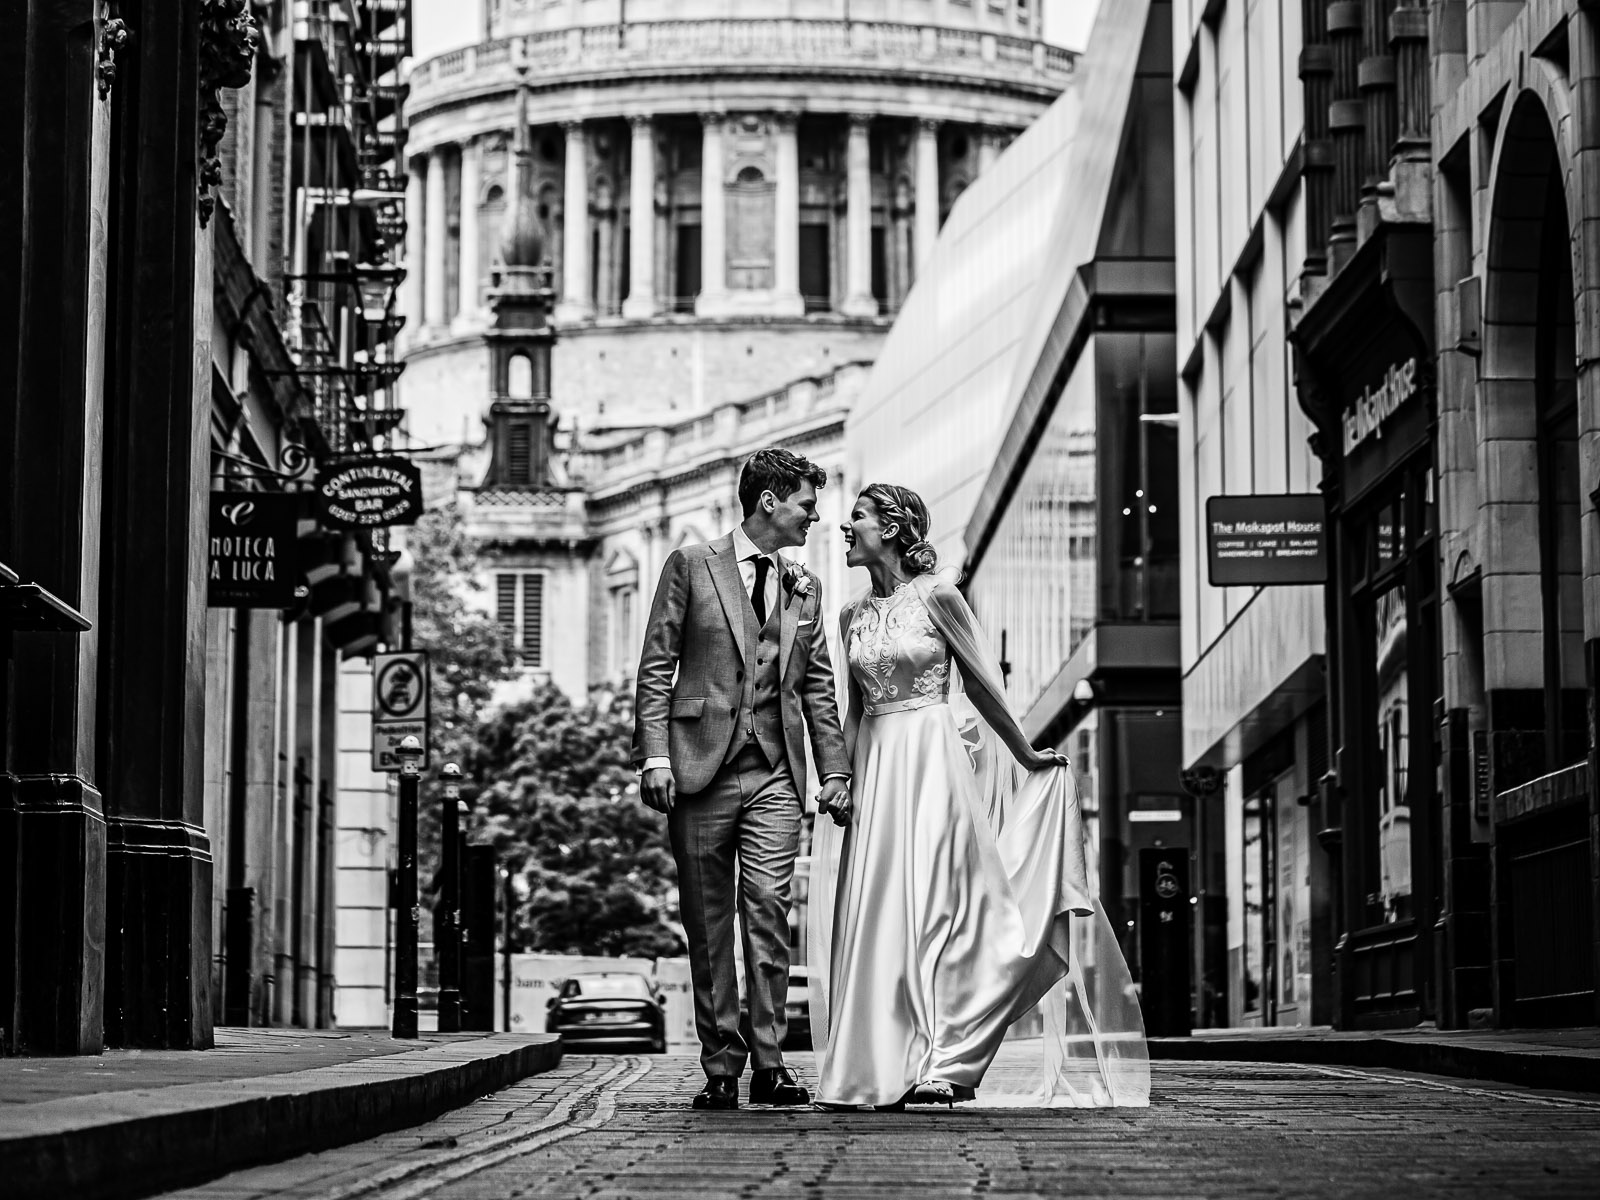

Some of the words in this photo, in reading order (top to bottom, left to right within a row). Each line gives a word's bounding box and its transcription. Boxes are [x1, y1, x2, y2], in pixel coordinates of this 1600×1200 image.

[322, 466, 413, 497] CONTINENTAL
[338, 486, 400, 500] SANDWICH
[354, 498, 383, 512] BAR
[1213, 522, 1233, 534] The
[1235, 521, 1285, 535] Mokapot
[1286, 520, 1321, 533] House
[210, 536, 275, 558] NOTECA
[210, 560, 220, 580] A
[232, 560, 275, 581] LUCA
